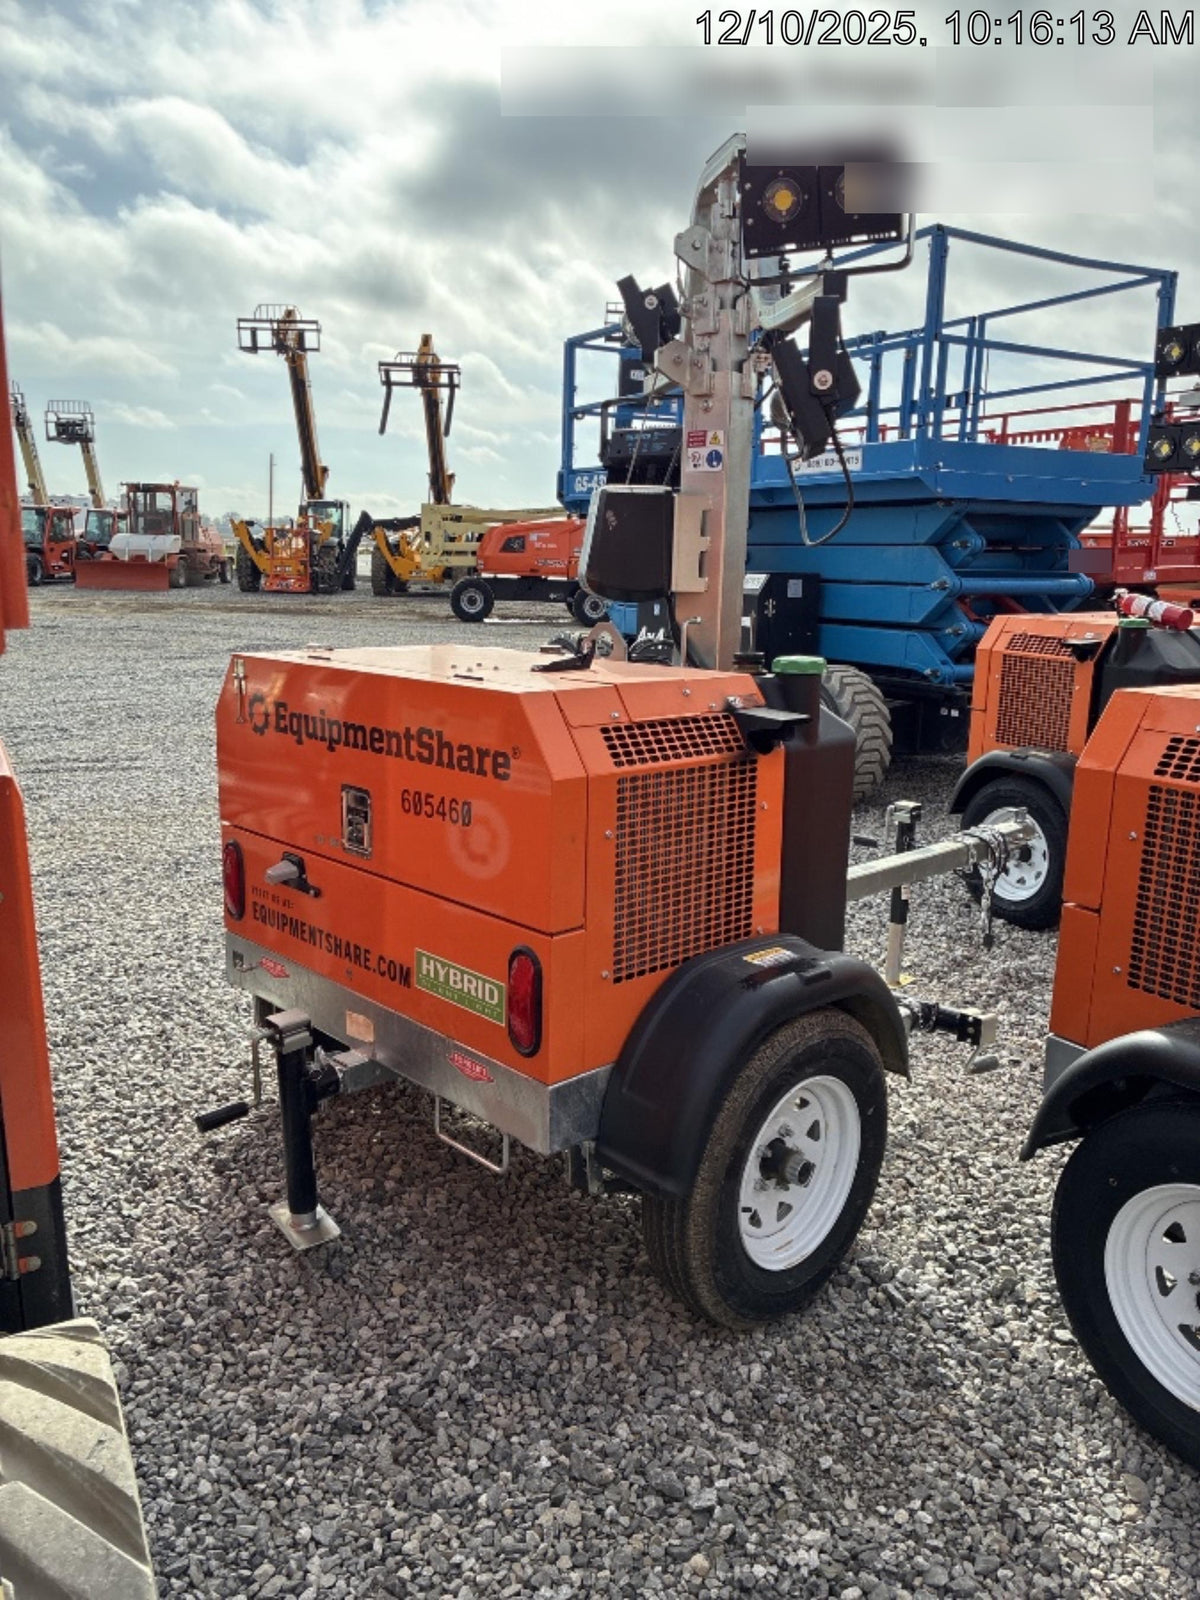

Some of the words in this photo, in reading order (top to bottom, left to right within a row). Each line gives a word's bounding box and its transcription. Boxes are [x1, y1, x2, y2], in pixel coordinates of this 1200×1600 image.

[274, 701, 511, 781] EquipmentShare
[401, 789, 472, 827] 605460
[252, 901, 412, 988] EQUIPMENTSHARE.COM
[421, 955, 499, 1006] HYBRID
